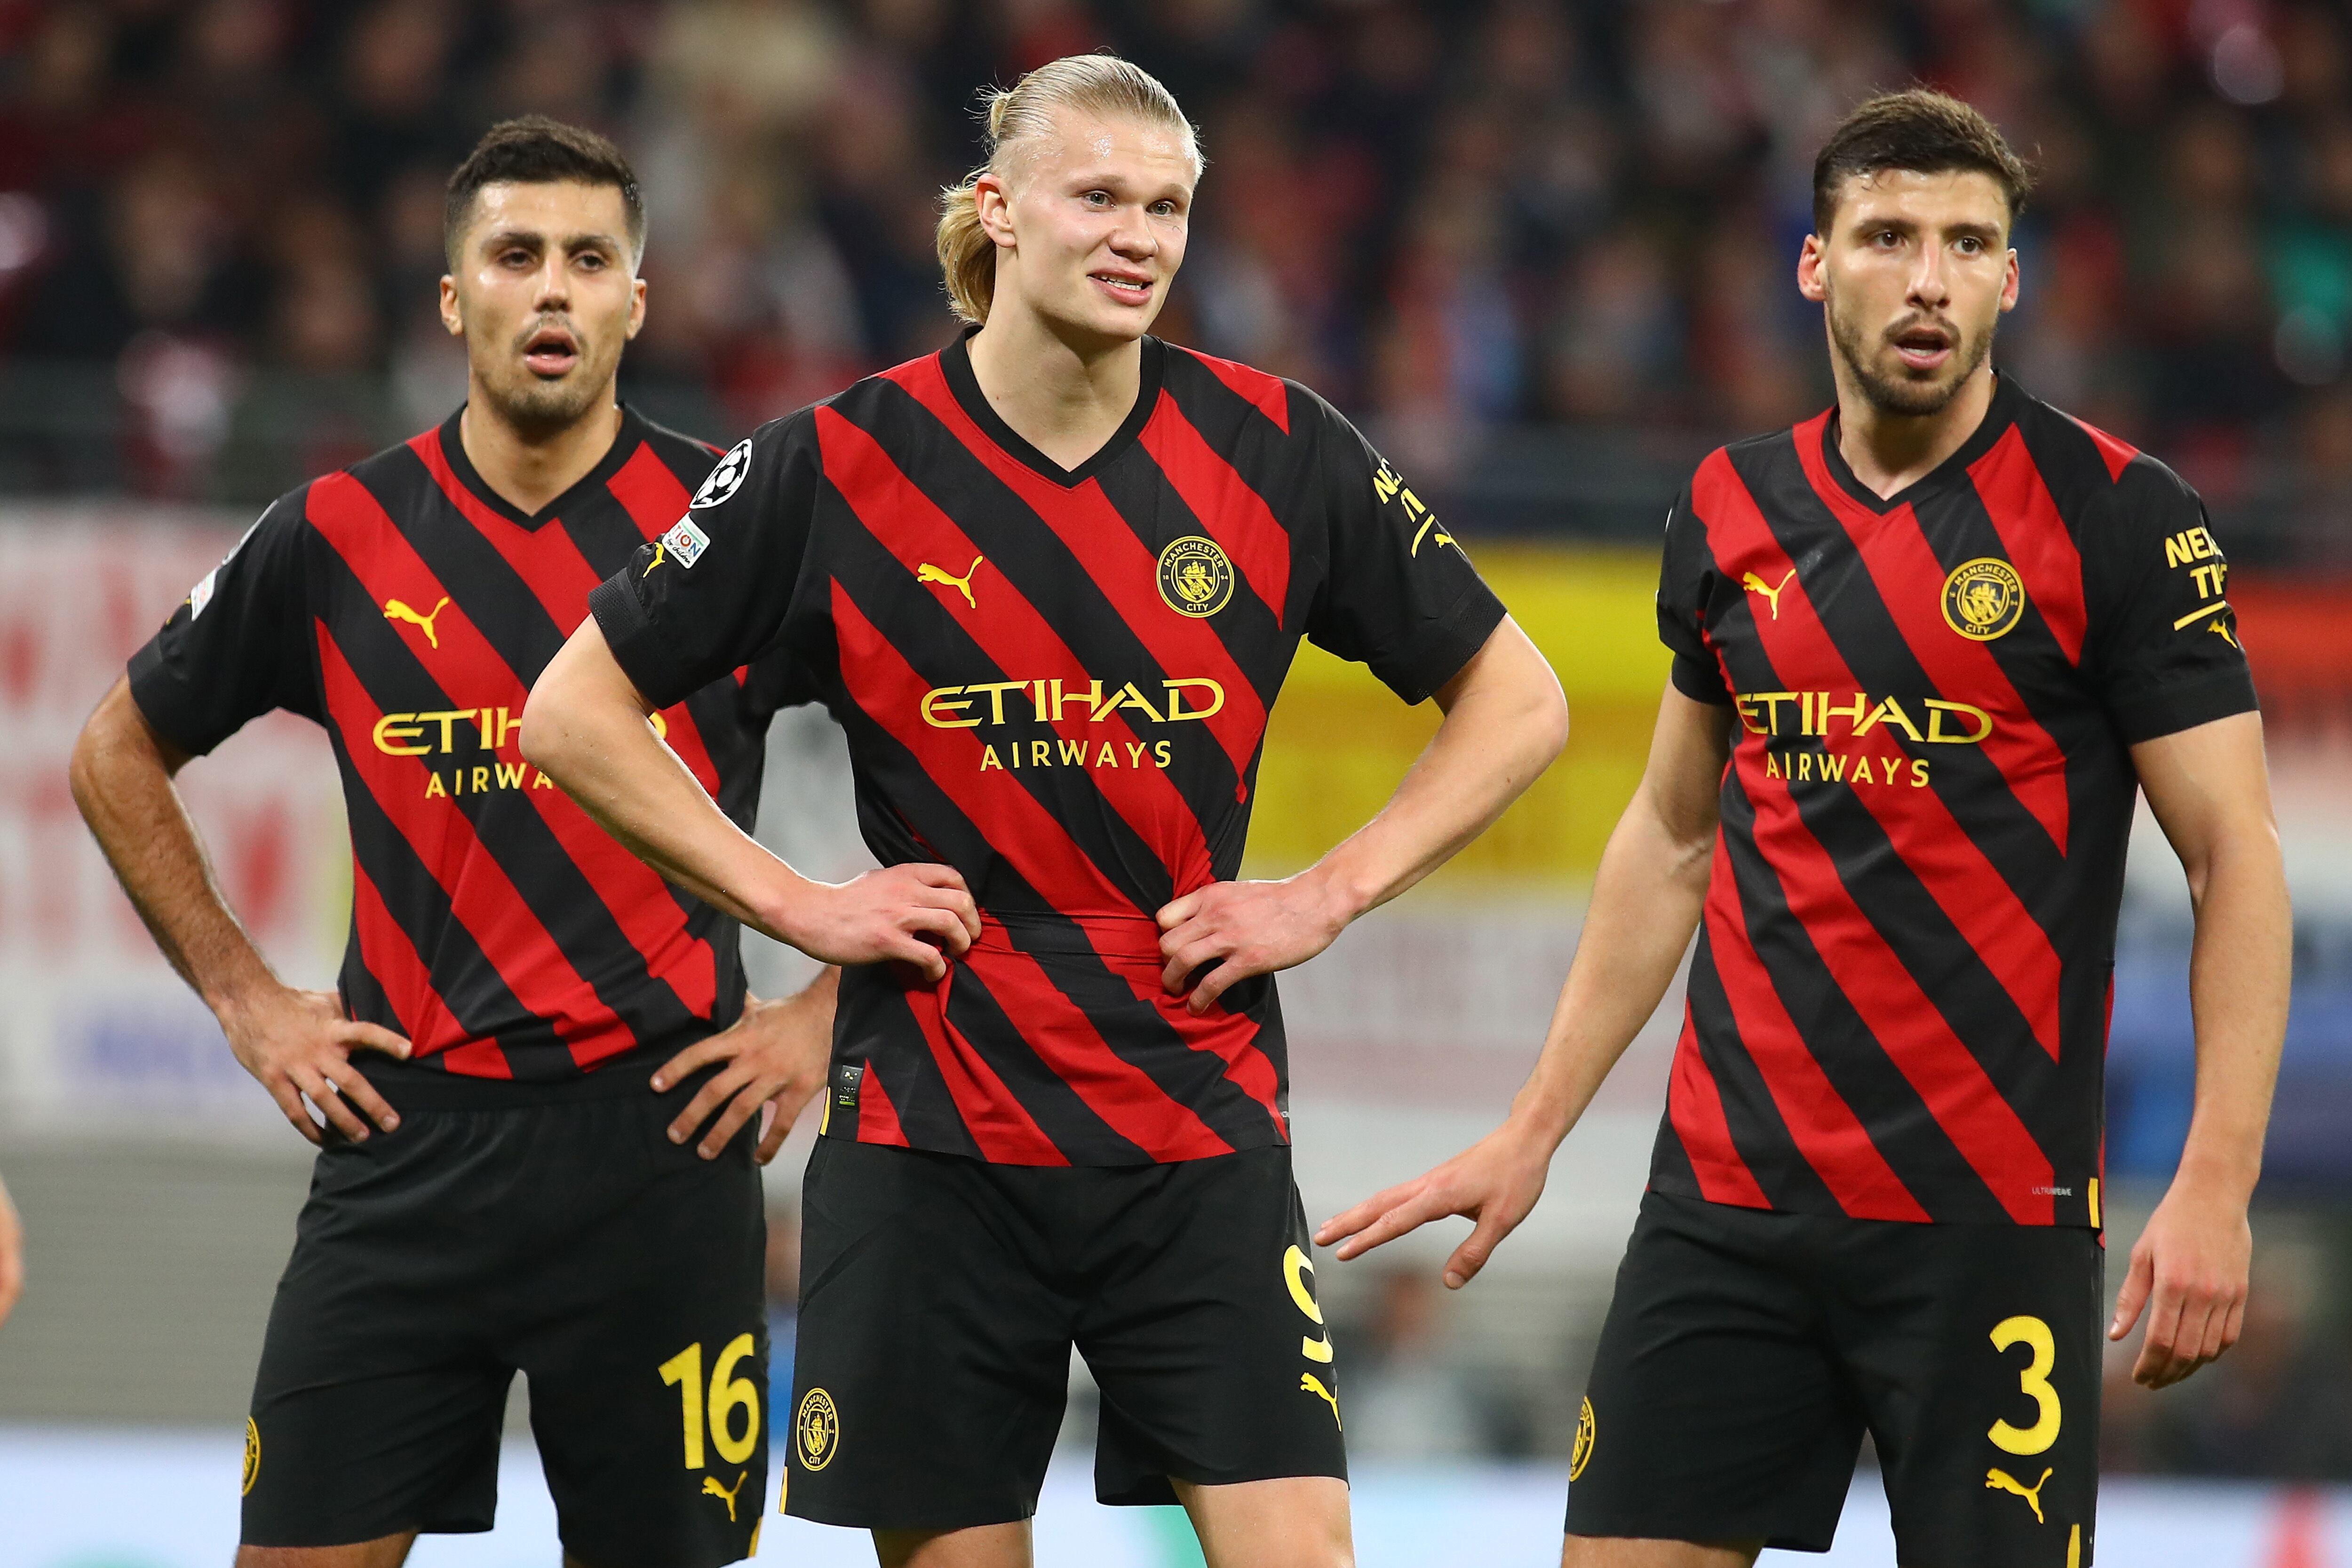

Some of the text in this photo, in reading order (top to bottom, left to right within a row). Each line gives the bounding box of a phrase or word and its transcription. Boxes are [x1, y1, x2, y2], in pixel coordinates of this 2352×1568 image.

[672, 546, 691, 565] children
[1164, 542, 1224, 567] MANCHESTER
[1954, 565, 2018, 592] MANCHESTER
[1965, 623, 1990, 634] CITY
[921, 678, 1224, 728] ETIHAD
[1736, 691, 1993, 744] ETIHAD
[980, 739, 1171, 772] AIRWAYS
[1766, 752, 1929, 788] AIRWAYS
[425, 762, 554, 798] AIRWA
[658, 1332, 760, 1470] 16
[1987, 1315, 2061, 1456] 3
[802, 1395, 833, 1421] MANCHESTER
[809, 1456, 821, 1465] CITY
